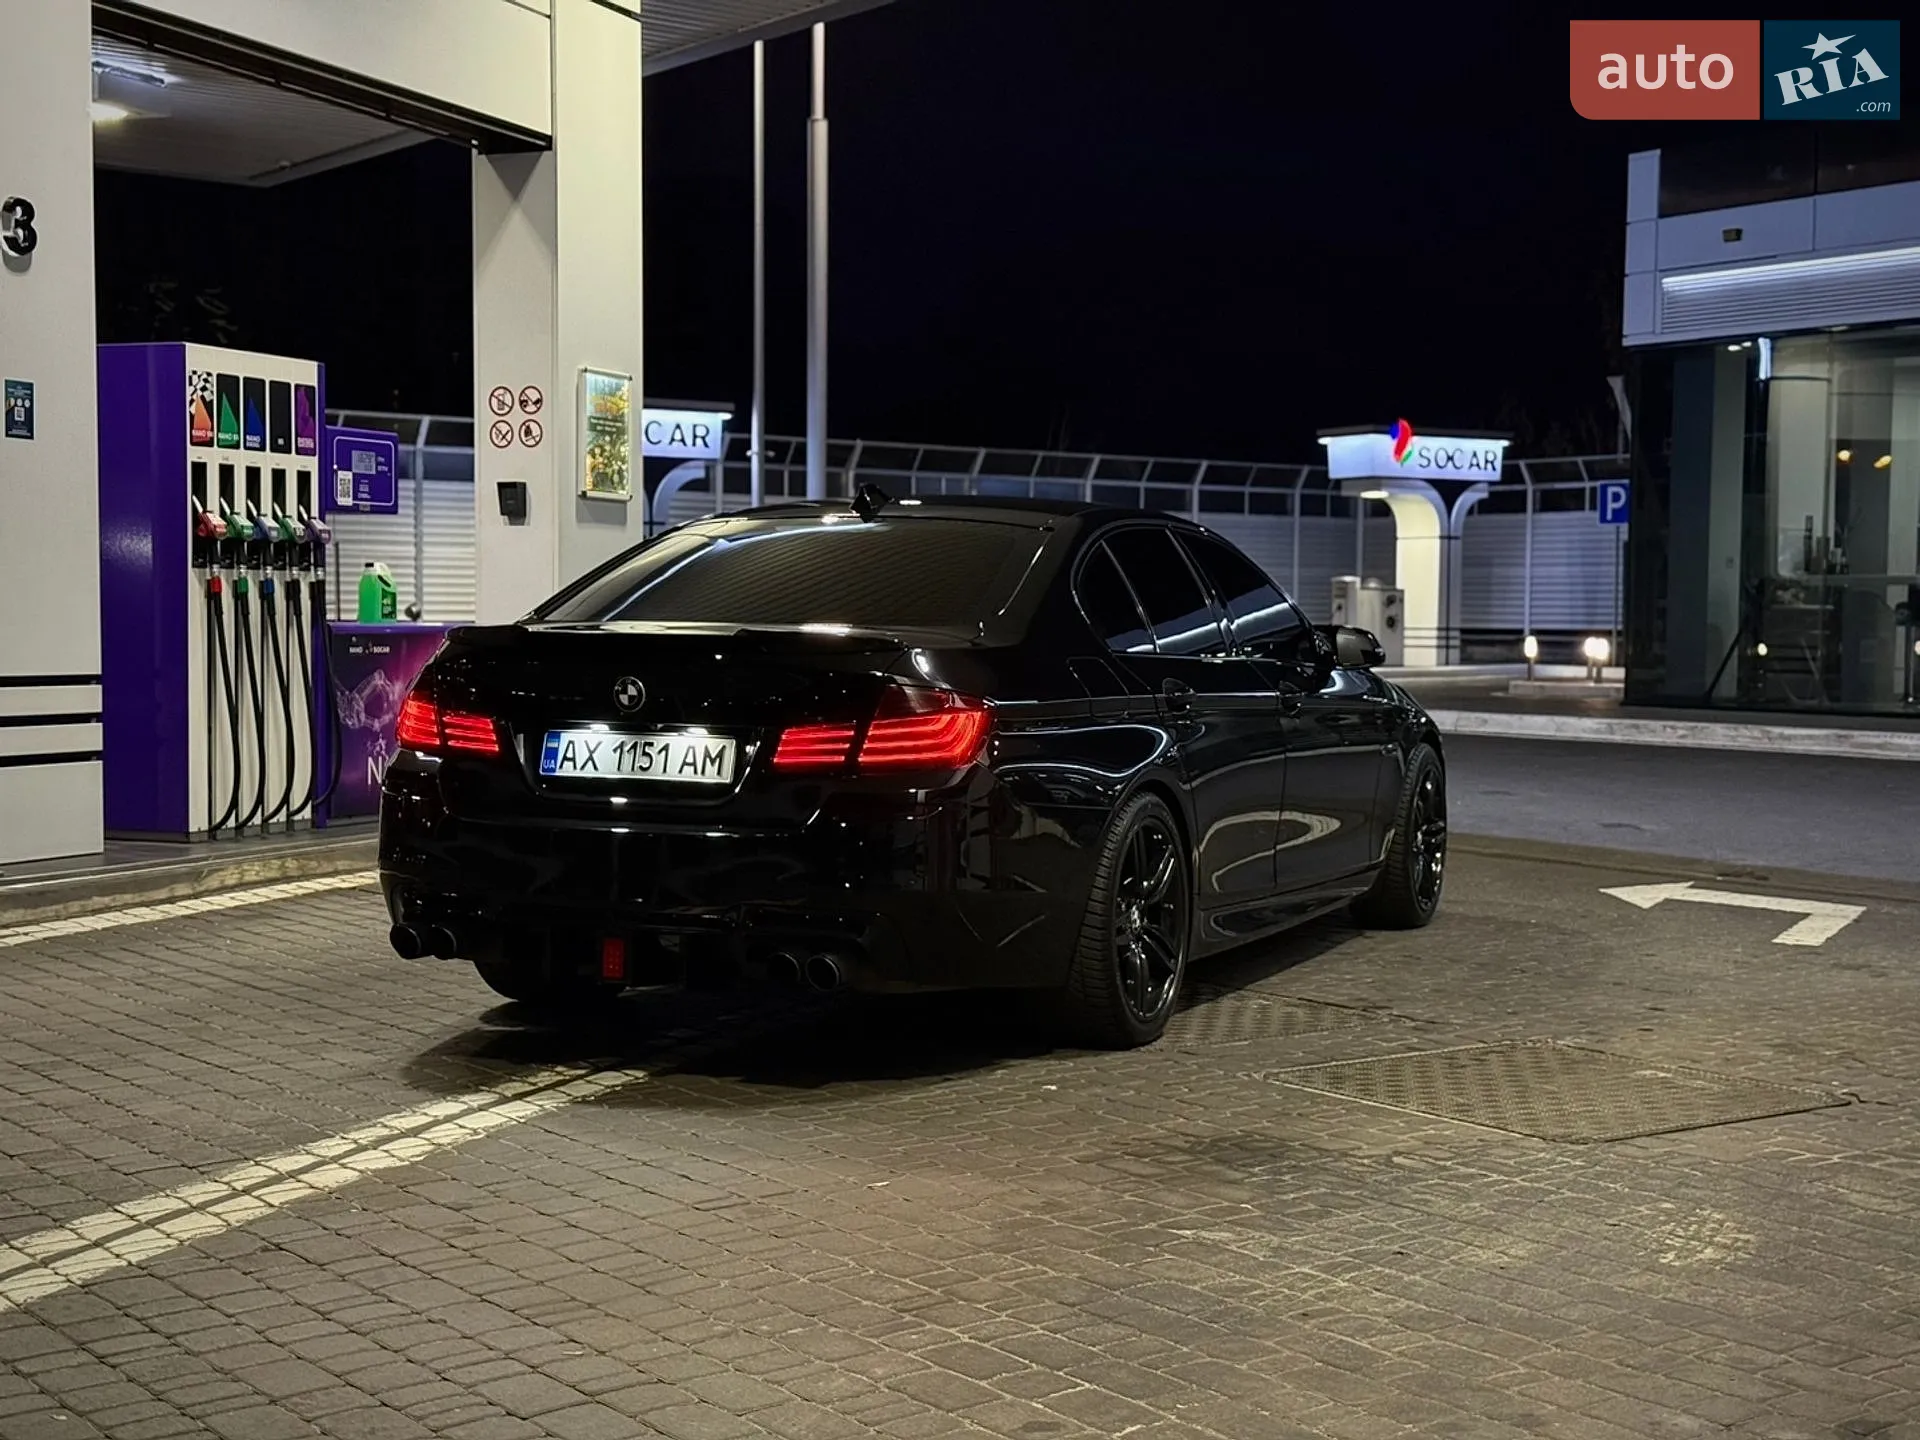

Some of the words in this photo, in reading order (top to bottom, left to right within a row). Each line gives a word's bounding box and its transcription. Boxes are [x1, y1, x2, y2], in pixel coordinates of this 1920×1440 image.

[1, 196, 37, 257] 3
[1417, 446, 1497, 472] SOCAR
[1605, 486, 1627, 521] P
[542, 759, 556, 770] UA
[558, 739, 602, 771] AX
[611, 740, 671, 774] 1151
[678, 744, 727, 777] AM
